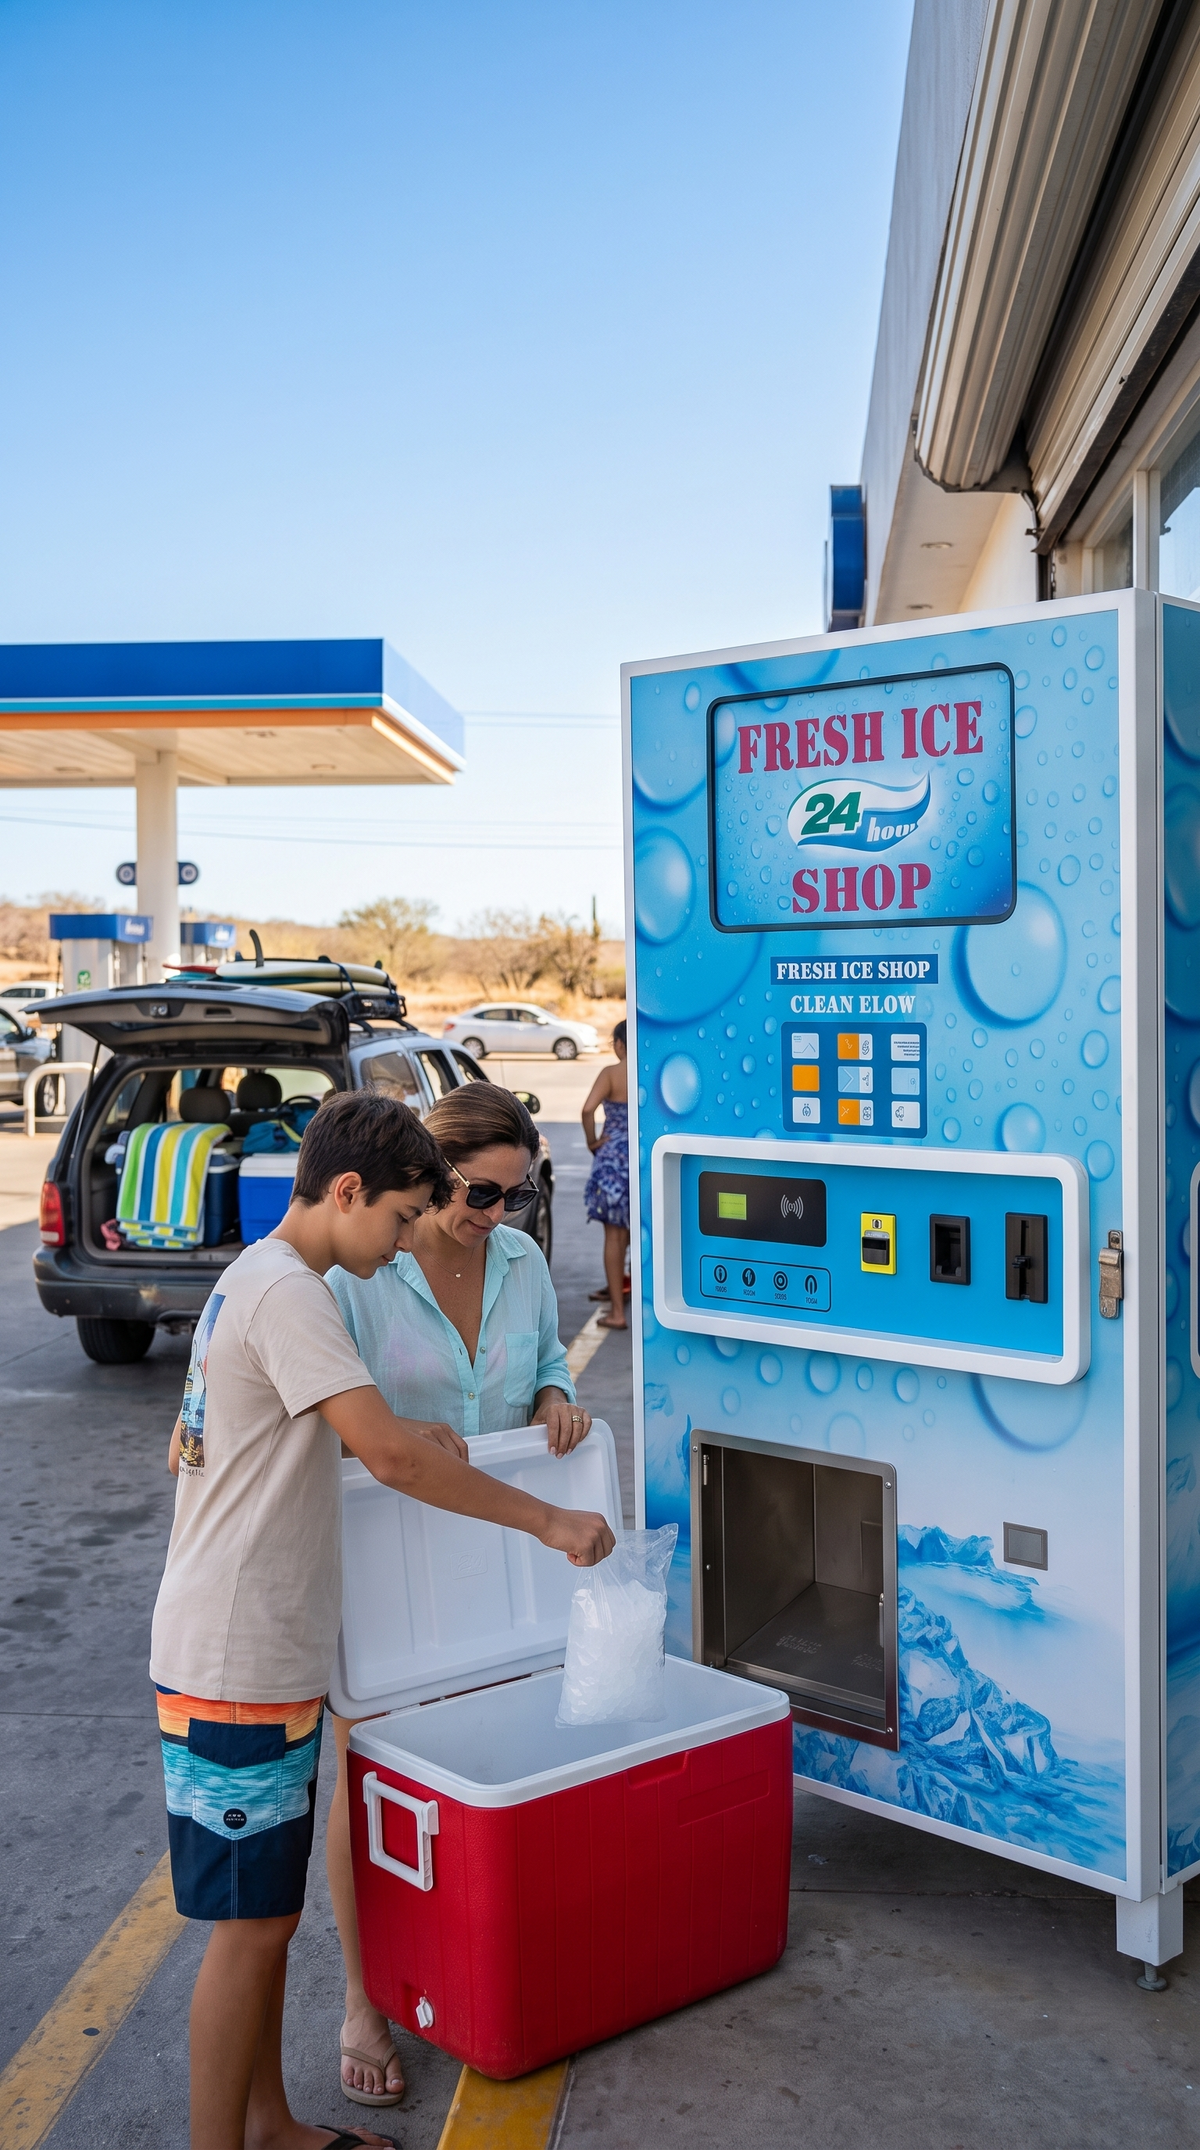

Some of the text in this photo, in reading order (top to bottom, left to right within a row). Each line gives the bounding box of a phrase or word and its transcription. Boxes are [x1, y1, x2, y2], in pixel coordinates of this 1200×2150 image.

[738, 701, 983, 774] FRESH ICE
[800, 791, 862, 836] 24
[792, 863, 932, 914] SHOP
[776, 960, 931, 980] FRESH ICE SHOP
[790, 994, 917, 1014] CLEAN ELOW
